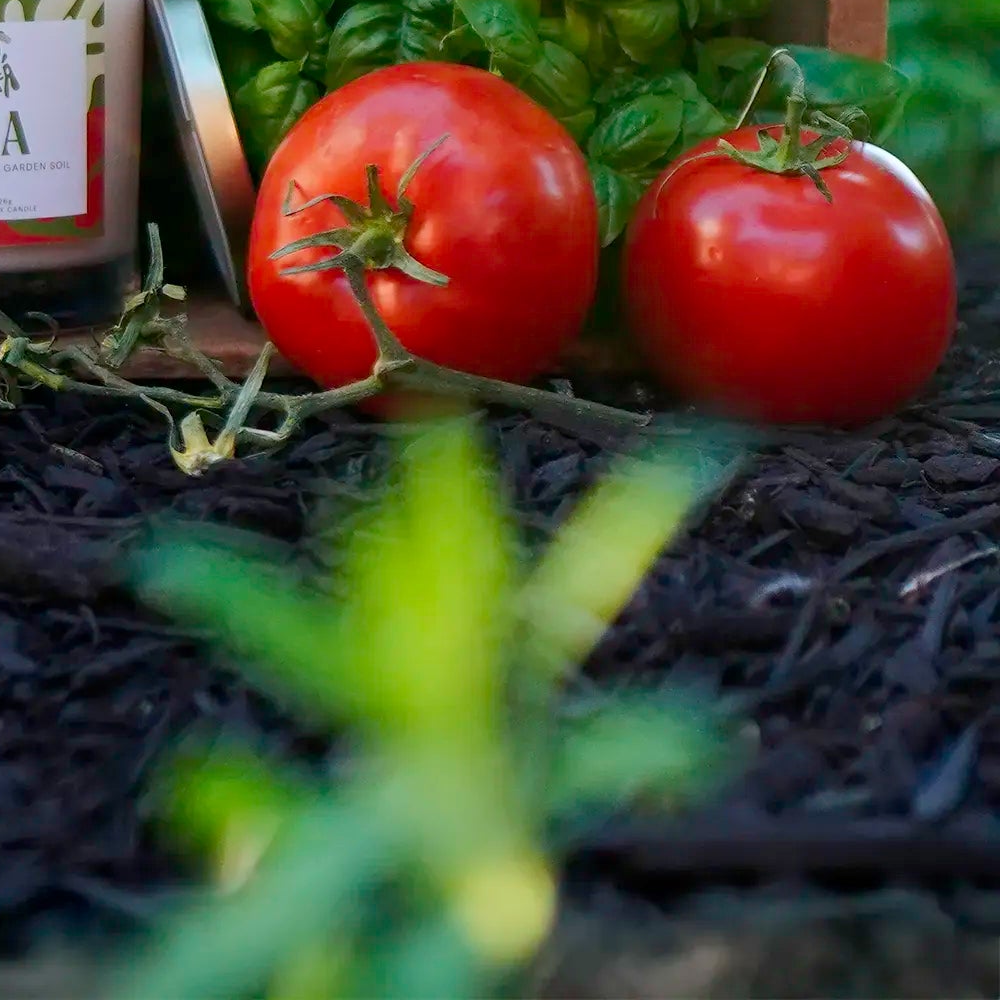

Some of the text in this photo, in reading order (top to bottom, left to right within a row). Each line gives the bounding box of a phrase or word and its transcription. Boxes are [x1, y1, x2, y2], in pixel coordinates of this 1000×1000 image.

[3, 162, 46, 172] GARDEN
[49, 160, 71, 170] SOIL
[6, 205, 38, 213] CANDLE
